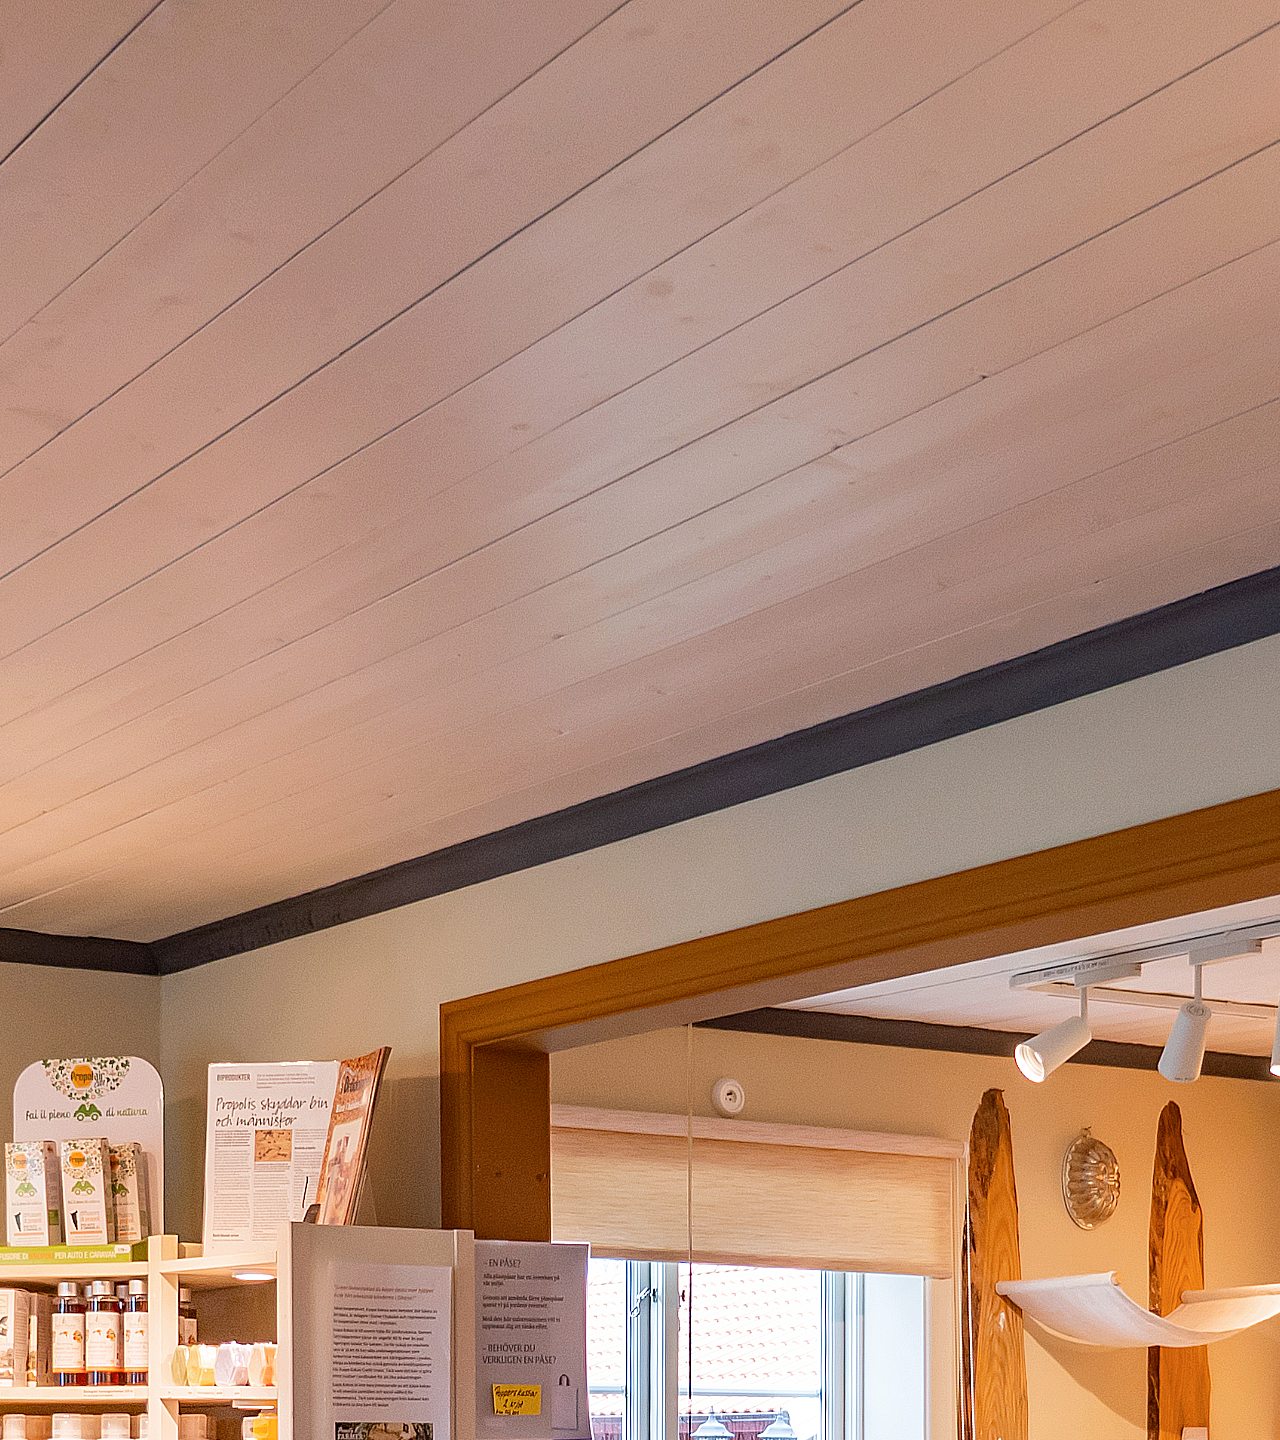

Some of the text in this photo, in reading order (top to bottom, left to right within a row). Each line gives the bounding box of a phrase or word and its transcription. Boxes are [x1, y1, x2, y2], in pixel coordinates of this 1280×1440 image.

[216, 1073, 251, 1082] BIPRODUKTER
[215, 1096, 257, 1116] Propolis
[260, 1095, 306, 1116] skyddar
[309, 1096, 329, 1109] bin
[25, 1107, 148, 1121] fai il pieno di natura
[215, 1112, 297, 1128] och människor
[488, 1257, 521, 1268] EN PÅSE?
[488, 1343, 536, 1353] BEHÖVER DU
[482, 1354, 557, 1364] VERKLIGEN EN PÅSE?
